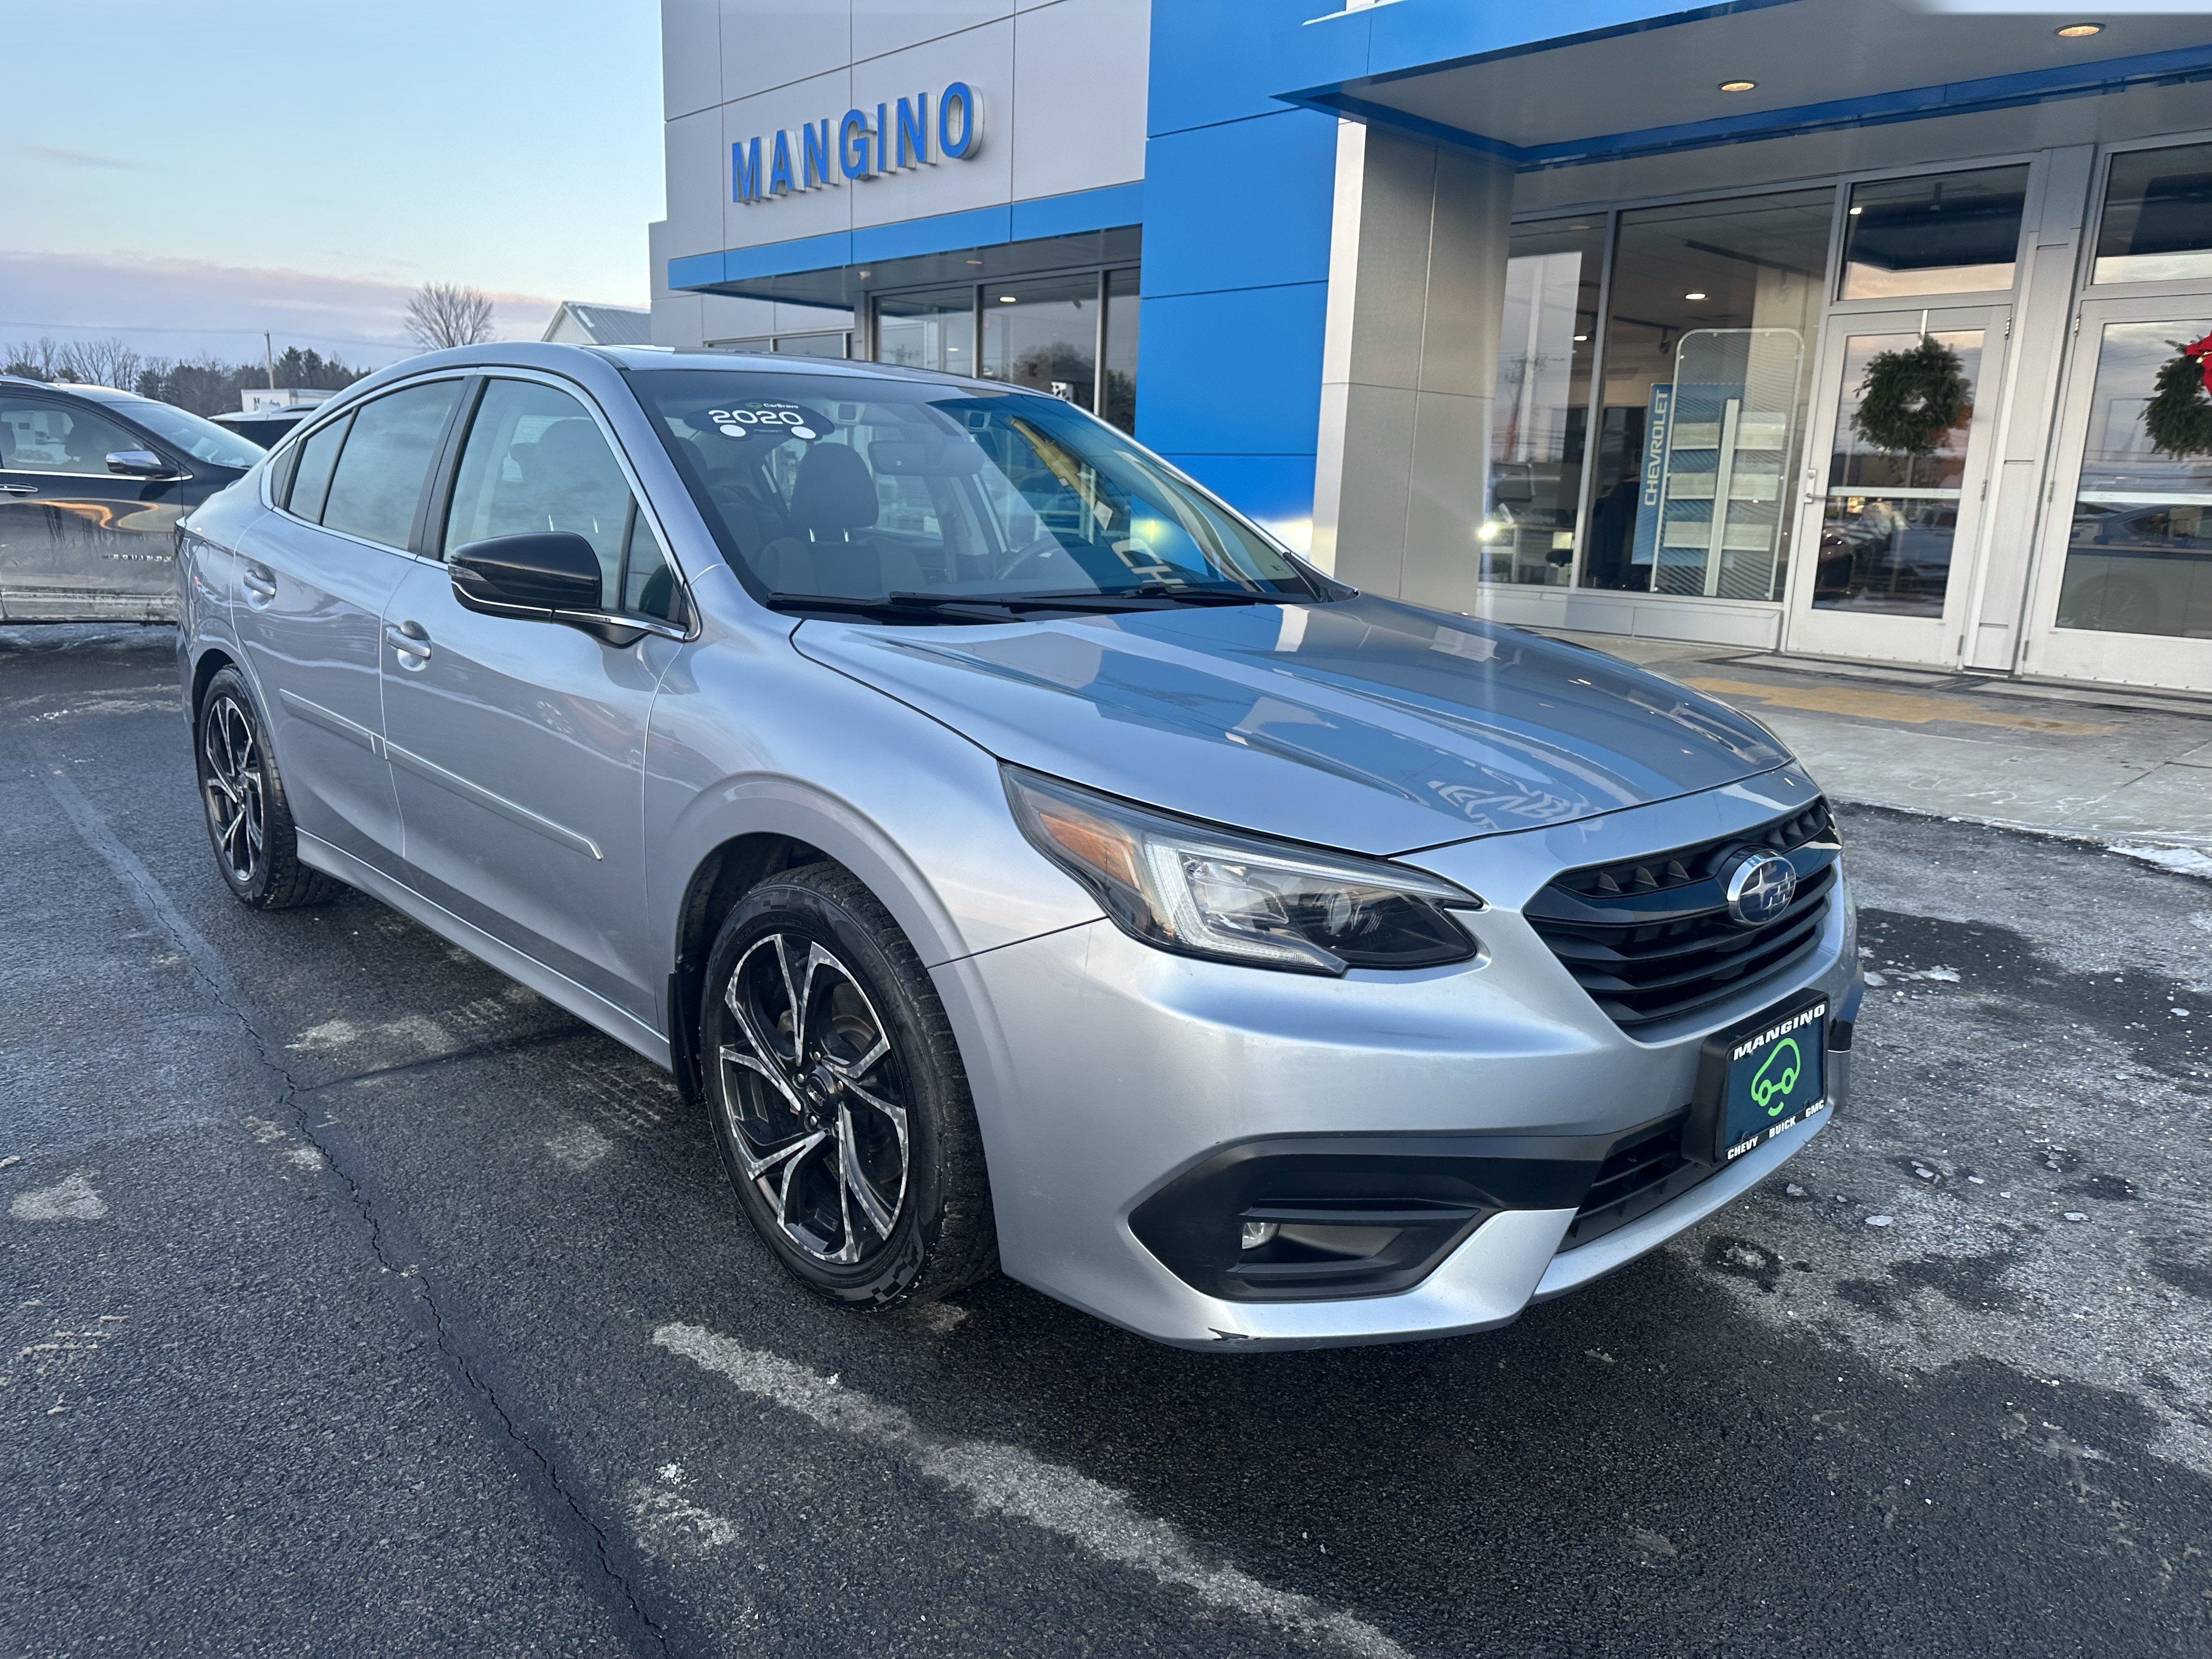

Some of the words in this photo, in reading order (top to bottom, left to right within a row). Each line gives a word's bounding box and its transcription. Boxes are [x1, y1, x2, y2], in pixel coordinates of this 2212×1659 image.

[732, 81, 984, 202] MANGINO
[708, 410, 804, 425] 2020
[1645, 390, 1668, 506] CHEVROLET
[1733, 1004, 1825, 1060] MANGINO
[1728, 1136, 1758, 1160] CHEVY
[1769, 1116, 1796, 1138] BUICK
[1805, 1099, 1824, 1118] GMC
